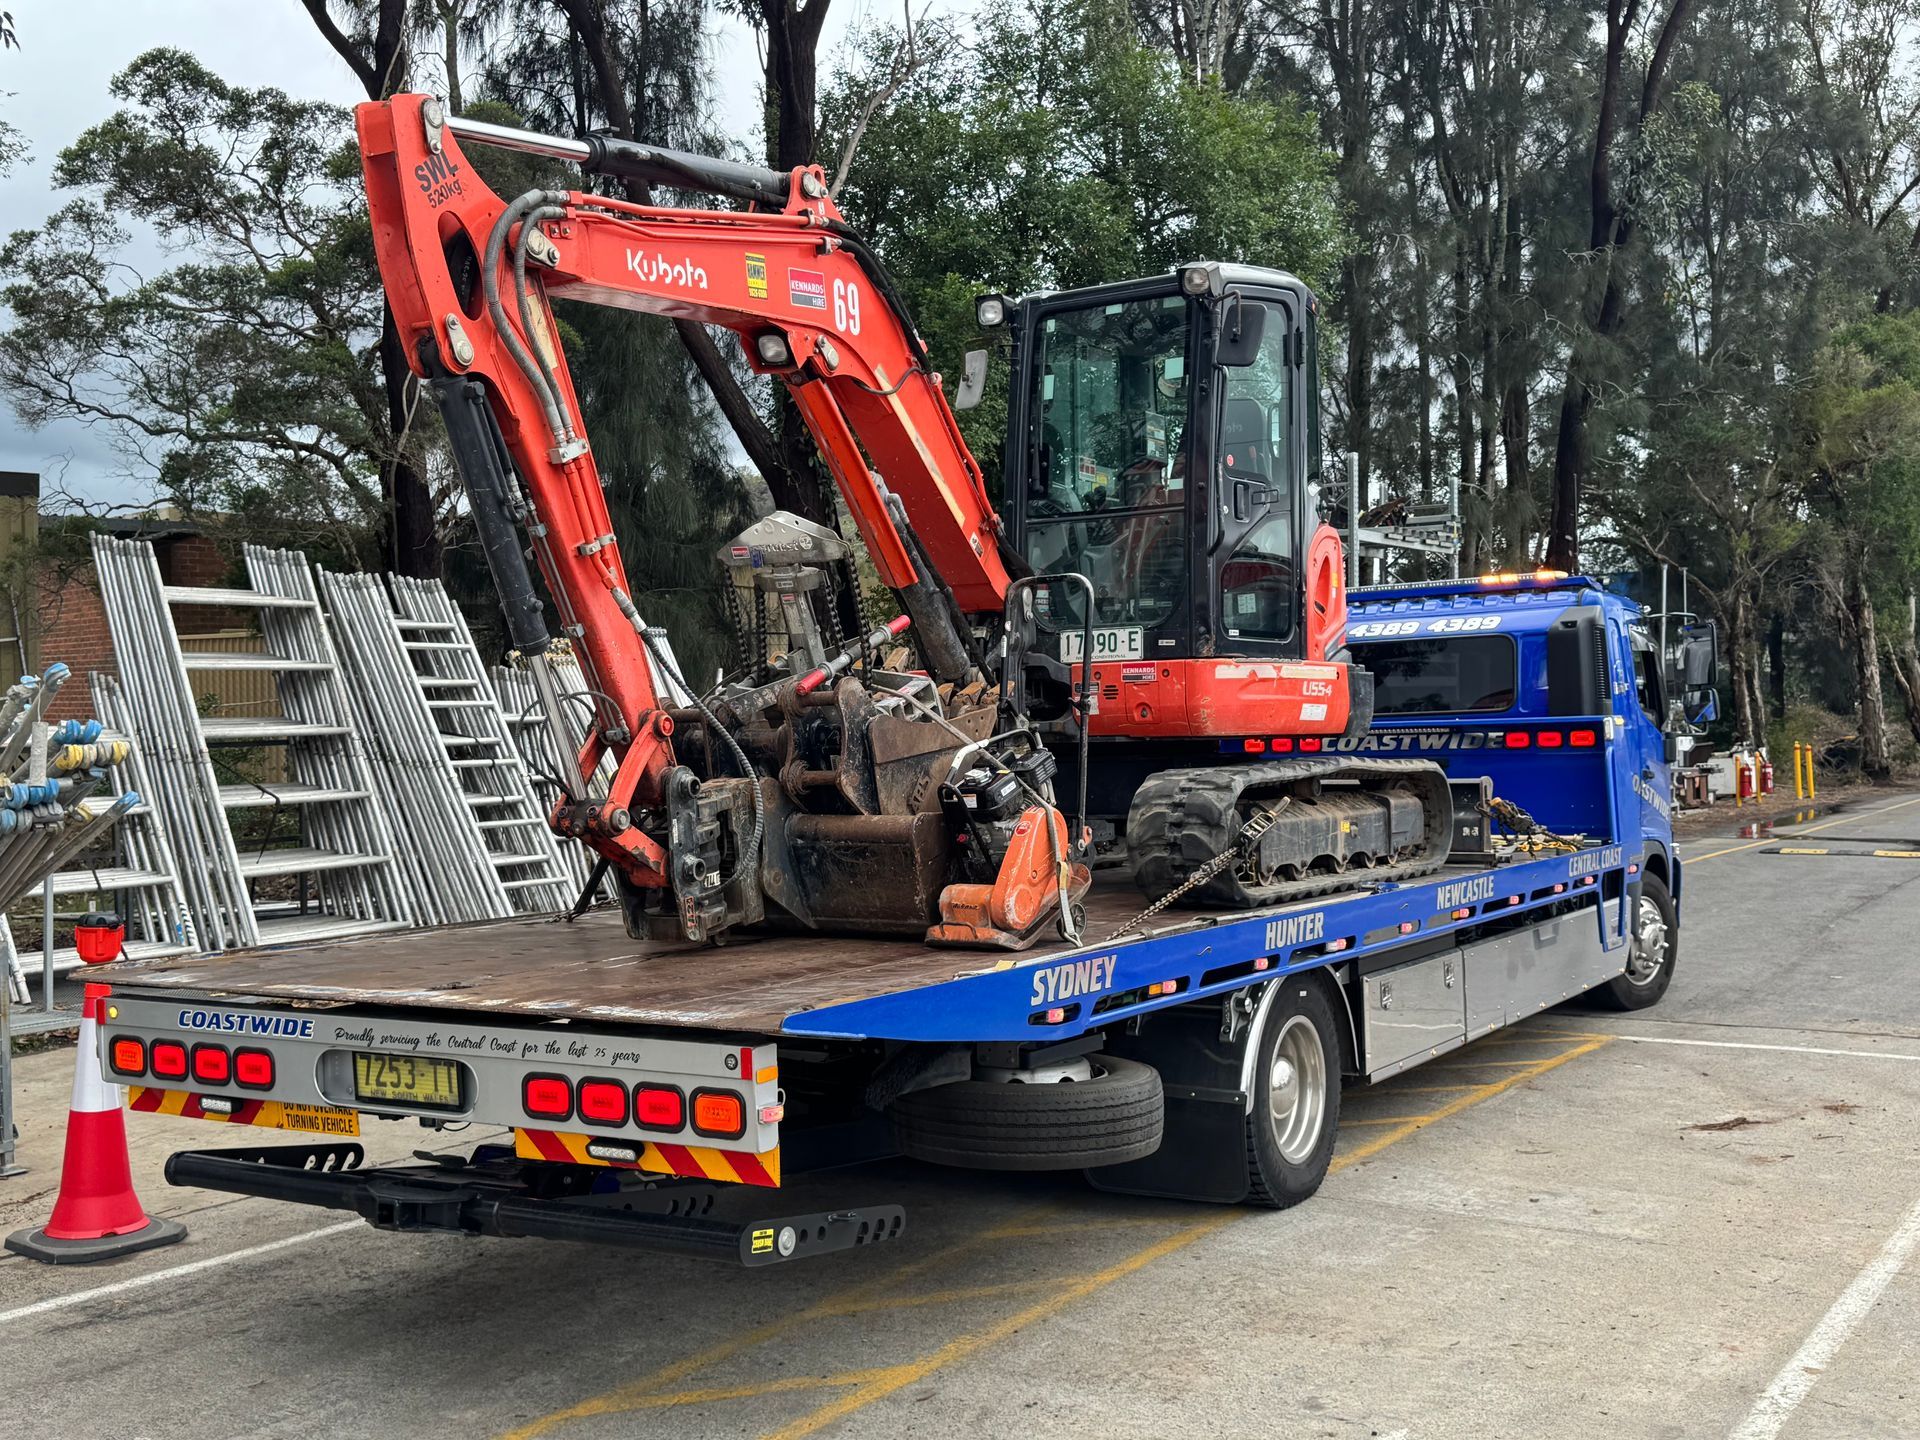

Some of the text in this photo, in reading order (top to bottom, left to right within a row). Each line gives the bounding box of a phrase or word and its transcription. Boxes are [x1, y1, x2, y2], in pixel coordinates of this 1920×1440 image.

[415, 149, 458, 192] SWL
[427, 179, 463, 208] 520kg
[626, 248, 708, 289] Kubota
[791, 281, 825, 294] KENNARDS
[812, 297, 826, 307] HIRE
[833, 278, 861, 336] 69
[1348, 616, 1502, 638] 4389 4389
[1122, 666, 1156, 674] KENNARDS
[1320, 731, 1505, 752] COASTWIDE
[1568, 846, 1622, 878] CENTRAL COAST
[1436, 876, 1495, 911] NEWCASTLE
[1265, 912, 1325, 951] HUNTER
[1030, 955, 1117, 1007] SYDNEY
[178, 1010, 315, 1038] COASTWIDE
[334, 1027, 641, 1066] Proudly servicing the Central Coast for the last 25 years
[391, 1090, 418, 1101] SOUTH
[286, 1113, 354, 1134] TURNING VEHICLE
